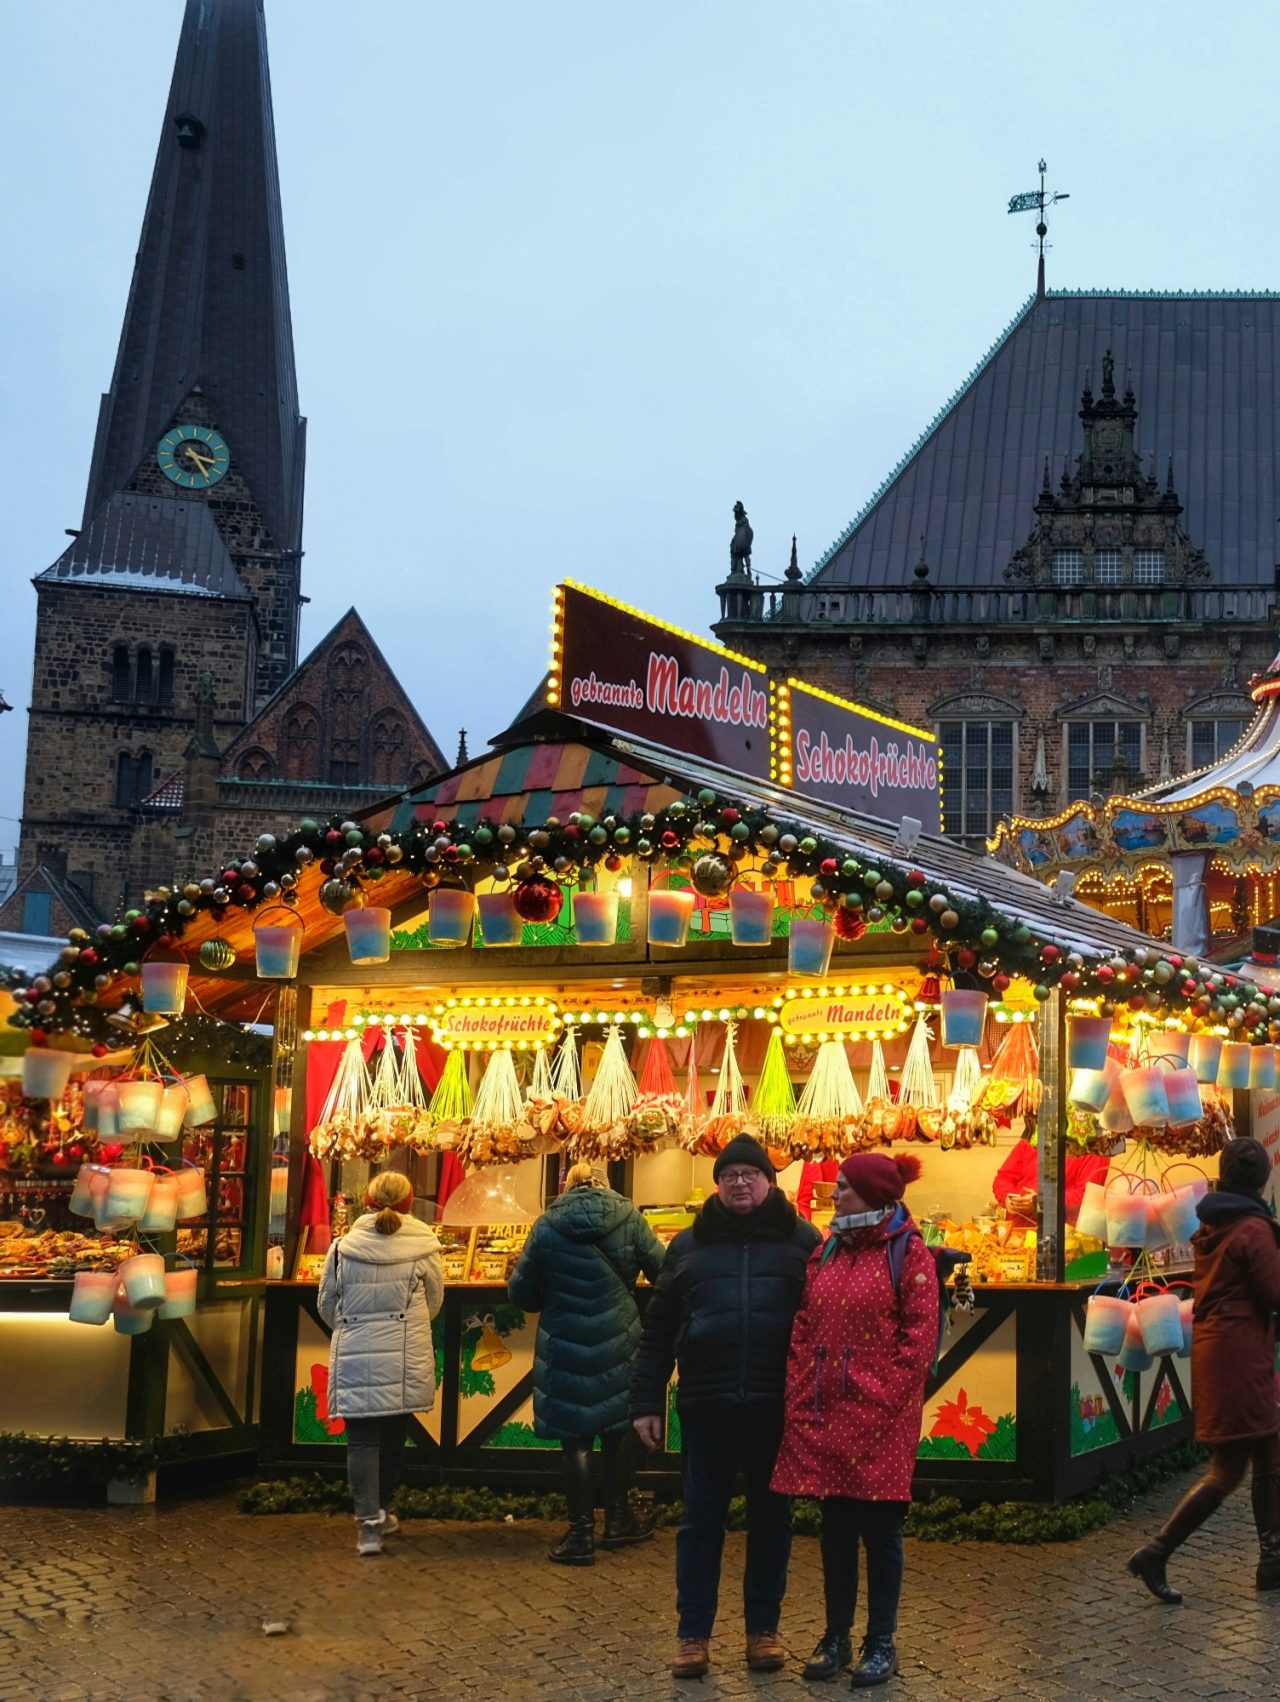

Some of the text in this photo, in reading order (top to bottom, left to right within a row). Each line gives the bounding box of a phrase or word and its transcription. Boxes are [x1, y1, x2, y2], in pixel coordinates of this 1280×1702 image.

[571, 652, 768, 729] gebrannte Mandeln
[796, 729, 938, 798] Schokofrüchte
[448, 1013, 552, 1036] Schokofrüchte
[787, 1003, 901, 1026] gebrannte Mandeln
[487, 1224, 533, 1238] PRALIN
